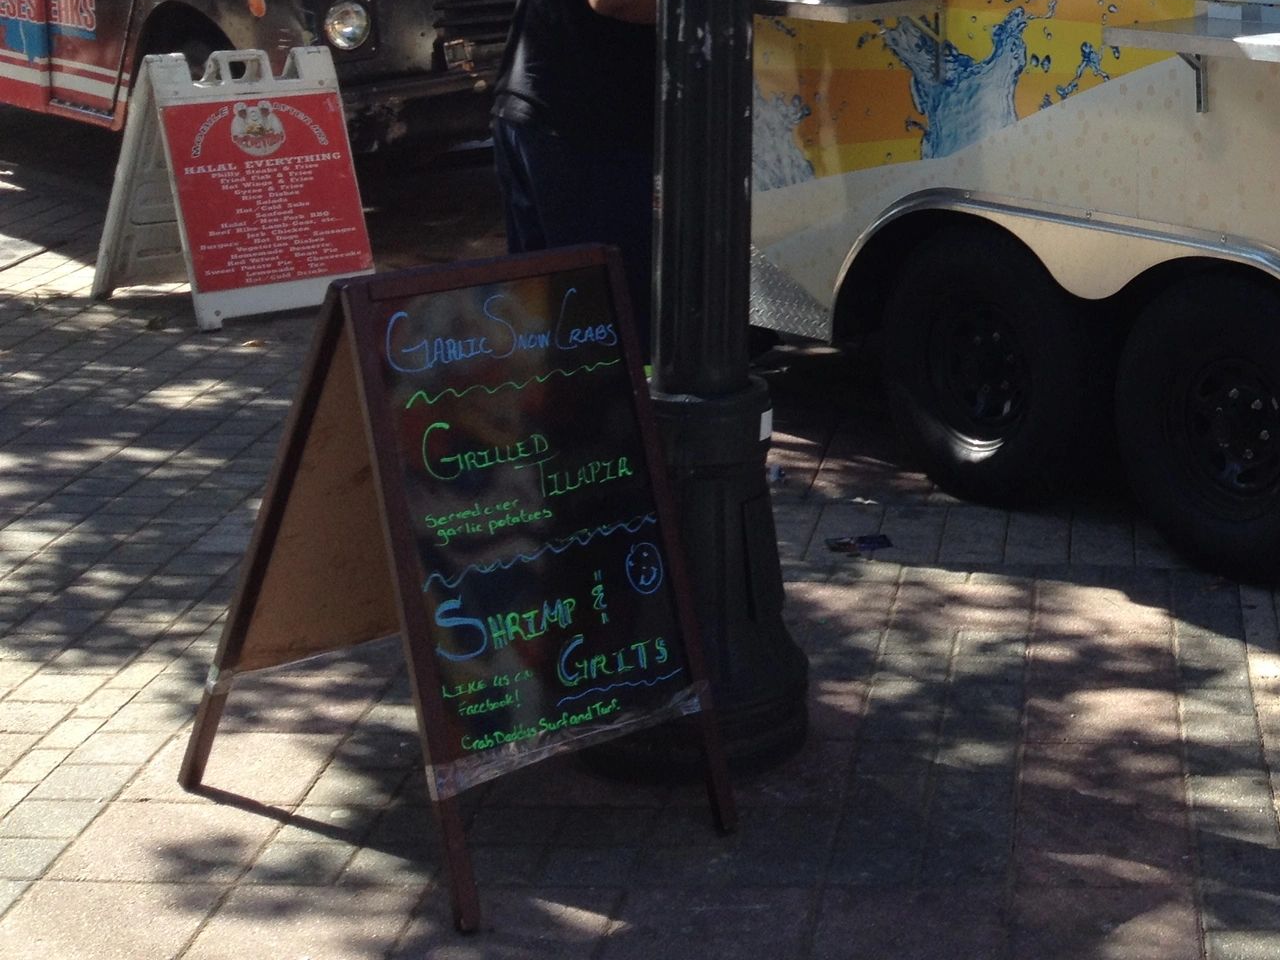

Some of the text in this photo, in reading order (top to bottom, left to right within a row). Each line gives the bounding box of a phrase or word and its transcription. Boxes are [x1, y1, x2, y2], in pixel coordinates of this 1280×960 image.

[386, 311, 493, 373] GARLIC
[556, 287, 618, 350] CRABS
[422, 422, 549, 481] GRILLED
[514, 451, 633, 498] TILAPIA
[434, 507, 553, 547] garlic potatoes
[434, 594, 576, 662] SHRIMP
[557, 633, 669, 687] GRITS
